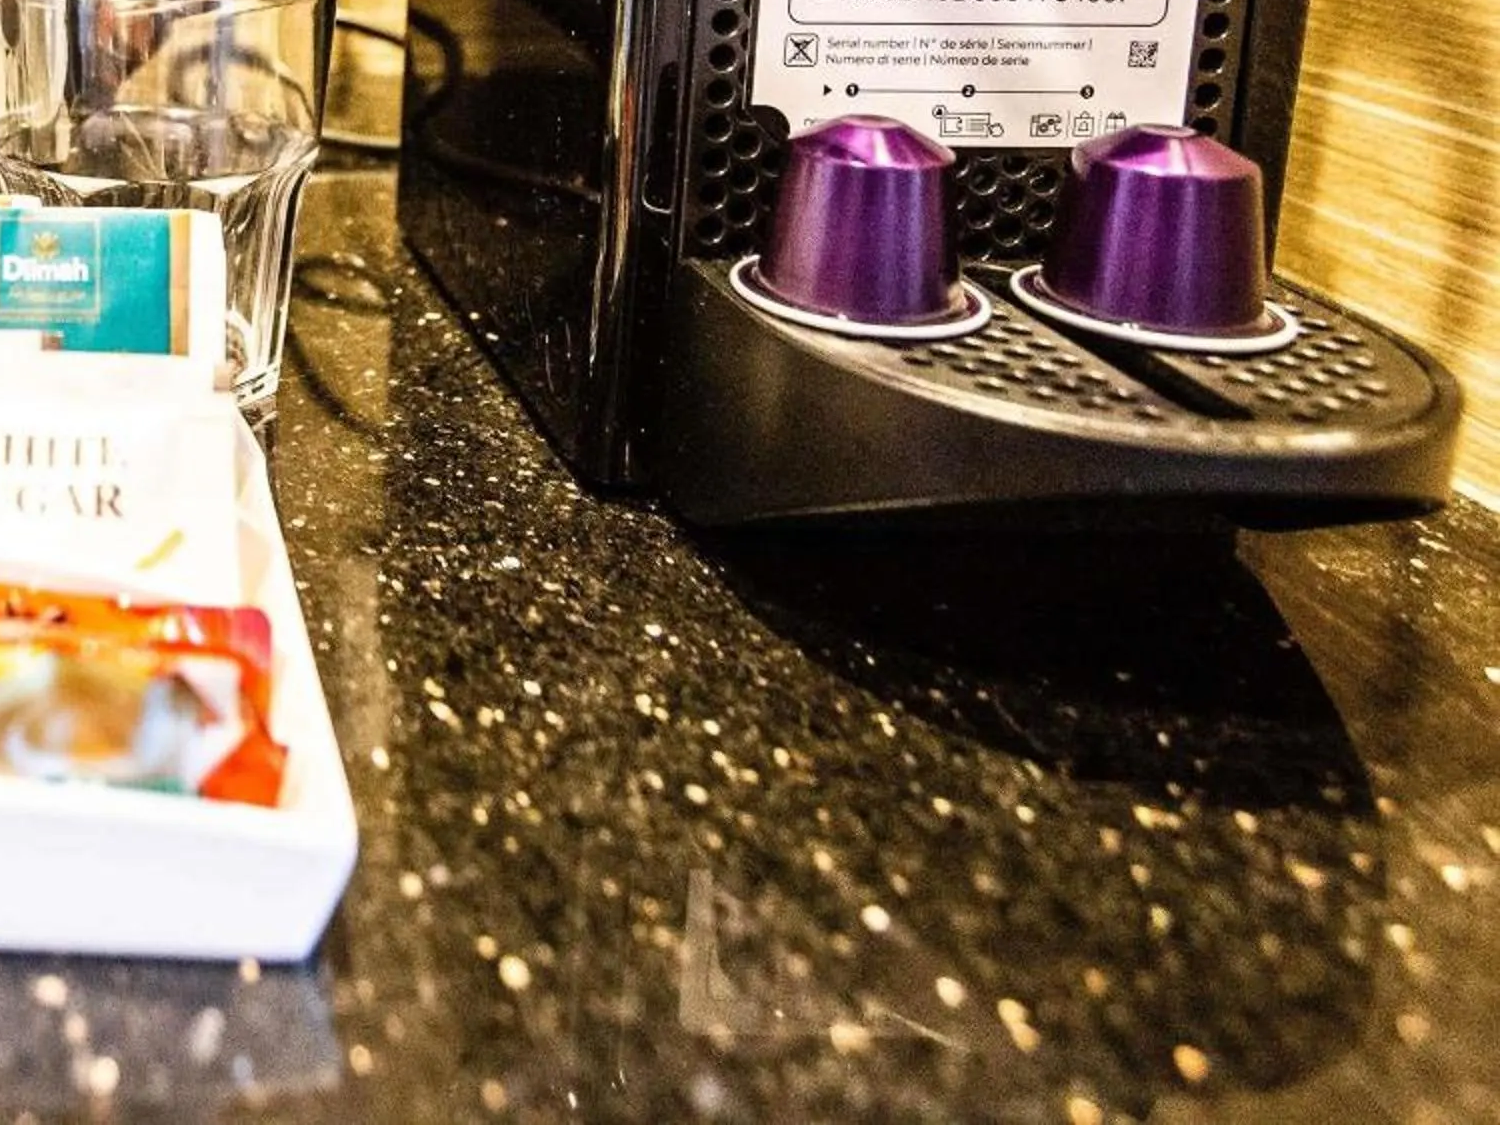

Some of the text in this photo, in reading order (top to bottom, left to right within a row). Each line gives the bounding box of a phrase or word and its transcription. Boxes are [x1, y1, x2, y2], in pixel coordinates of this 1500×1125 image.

[827, 36, 861, 49] Serial
[863, 37, 911, 49] number
[940, 38, 957, 50] de
[825, 54, 875, 66] Numero
[892, 55, 921, 66] serie
[929, 54, 979, 67] Número
[981, 55, 998, 66] de
[1000, 55, 1030, 67] serie
[2, 254, 90, 282] Dilmah
